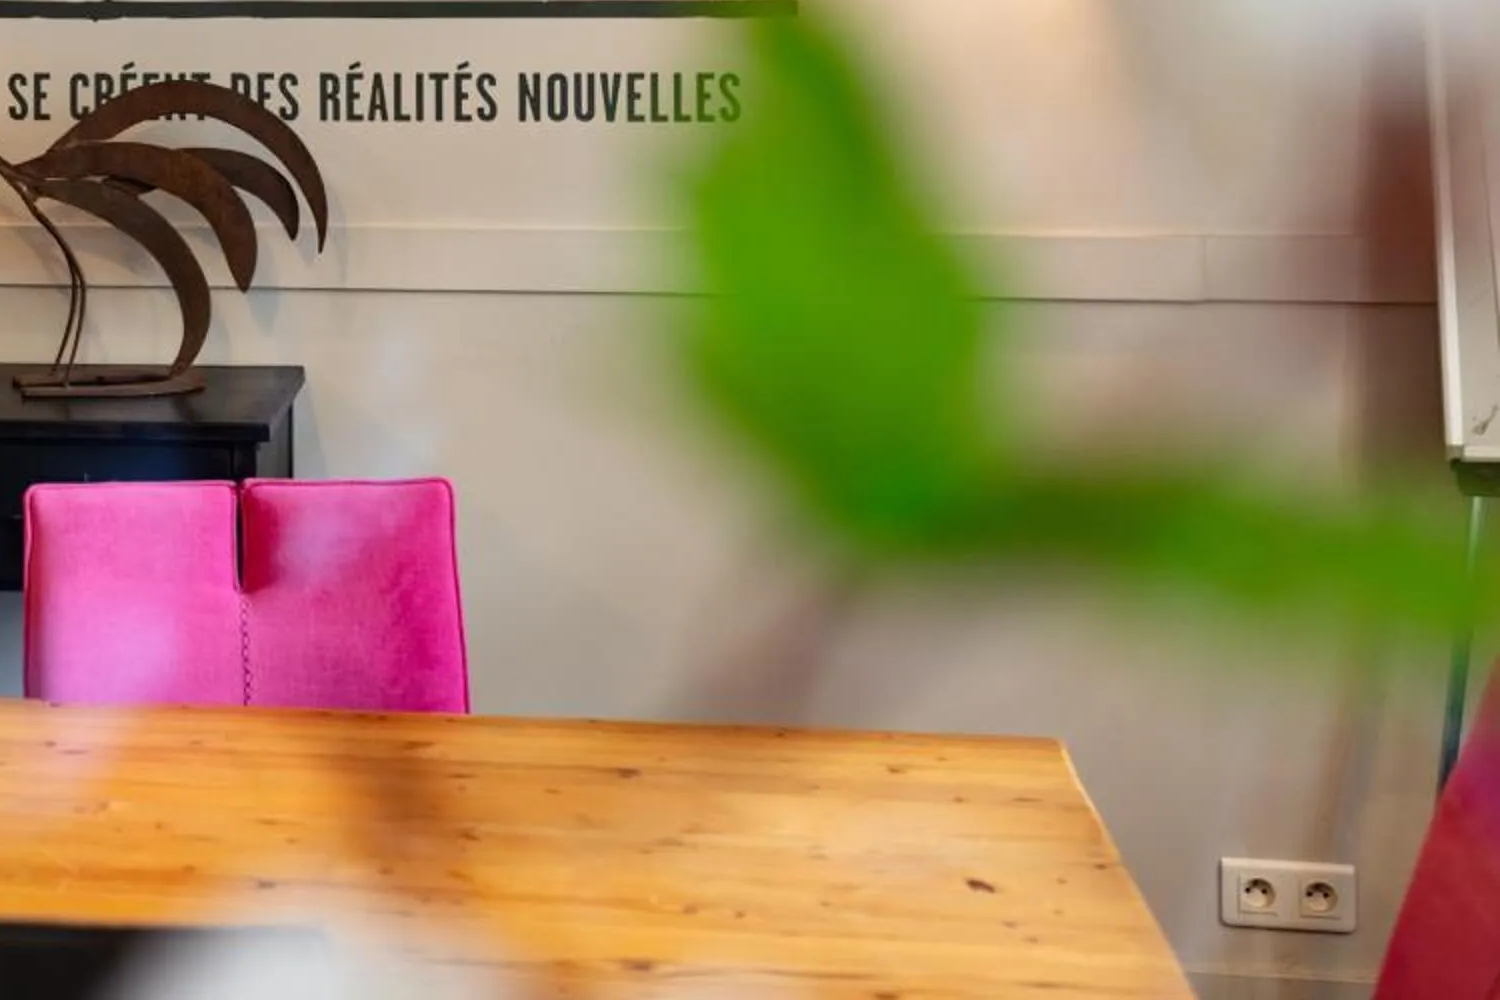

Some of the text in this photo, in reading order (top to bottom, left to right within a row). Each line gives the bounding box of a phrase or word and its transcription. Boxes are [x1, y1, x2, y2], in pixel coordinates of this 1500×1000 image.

[8, 72, 51, 120] SE
[319, 61, 498, 122] RÉALITÉS
[518, 72, 741, 122] NOUVELLES
